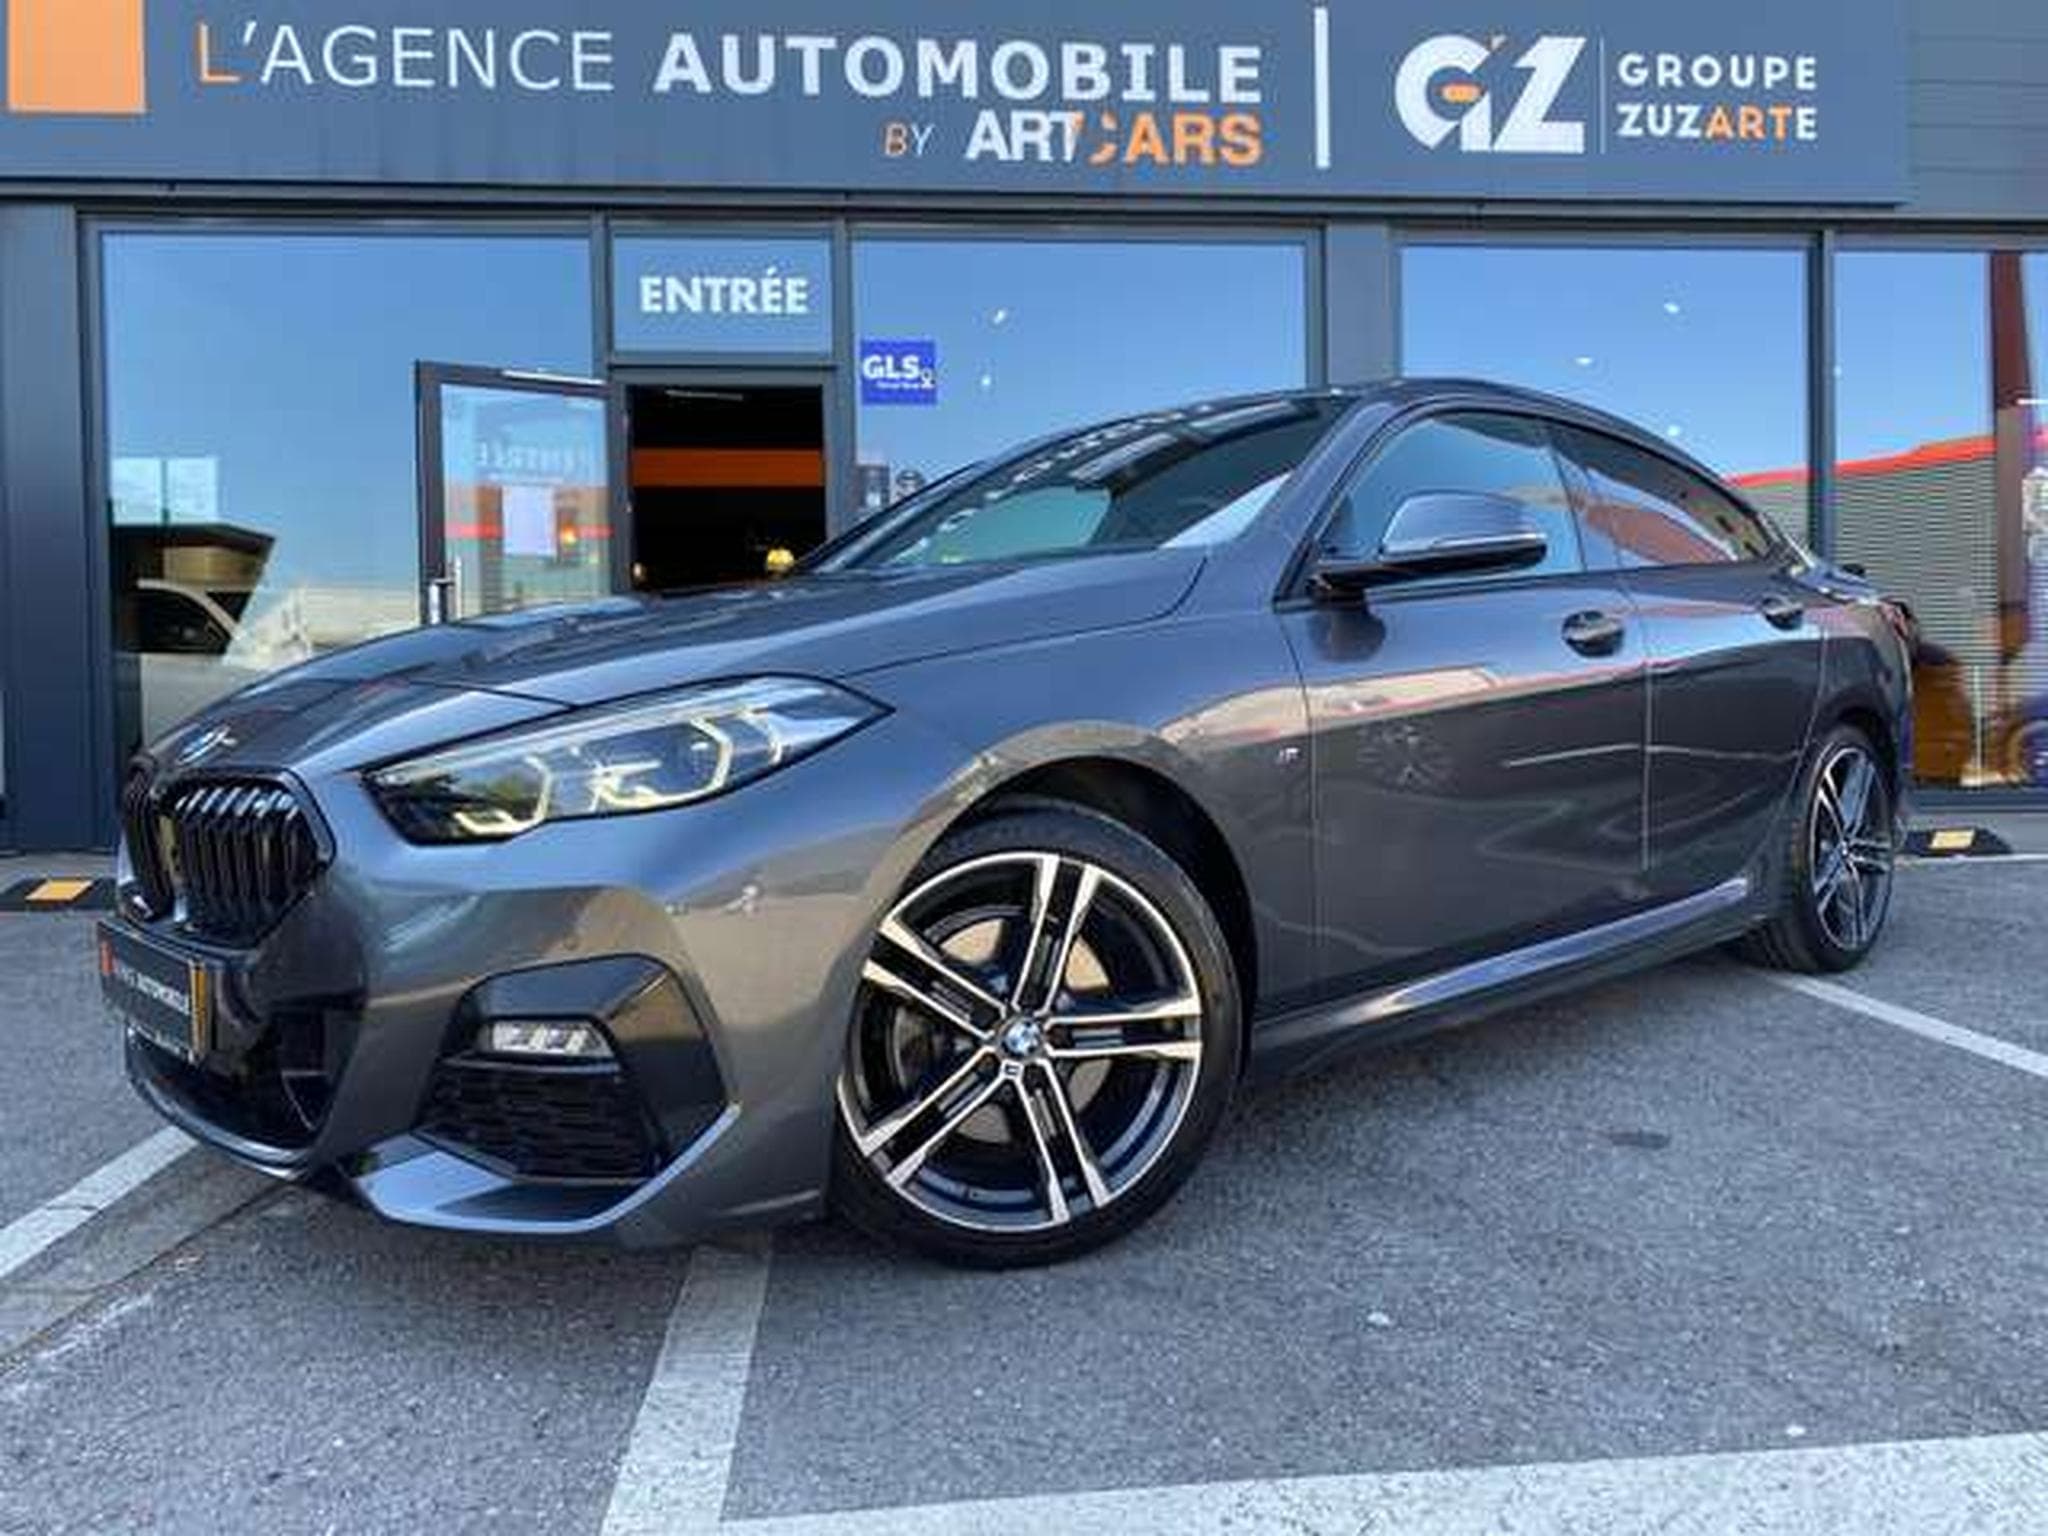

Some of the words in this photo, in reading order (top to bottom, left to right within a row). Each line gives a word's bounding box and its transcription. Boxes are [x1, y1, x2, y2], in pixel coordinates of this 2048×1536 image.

[198, 20, 614, 92] L'AGENCE
[652, 33, 1263, 103] AUTOMOBILE
[1617, 53, 1818, 89] GROUPE
[883, 123, 936, 157] BY
[1617, 103, 1818, 141] ZUZARTE
[639, 265, 810, 315] ENTRÉE
[862, 353, 921, 380] GLS
